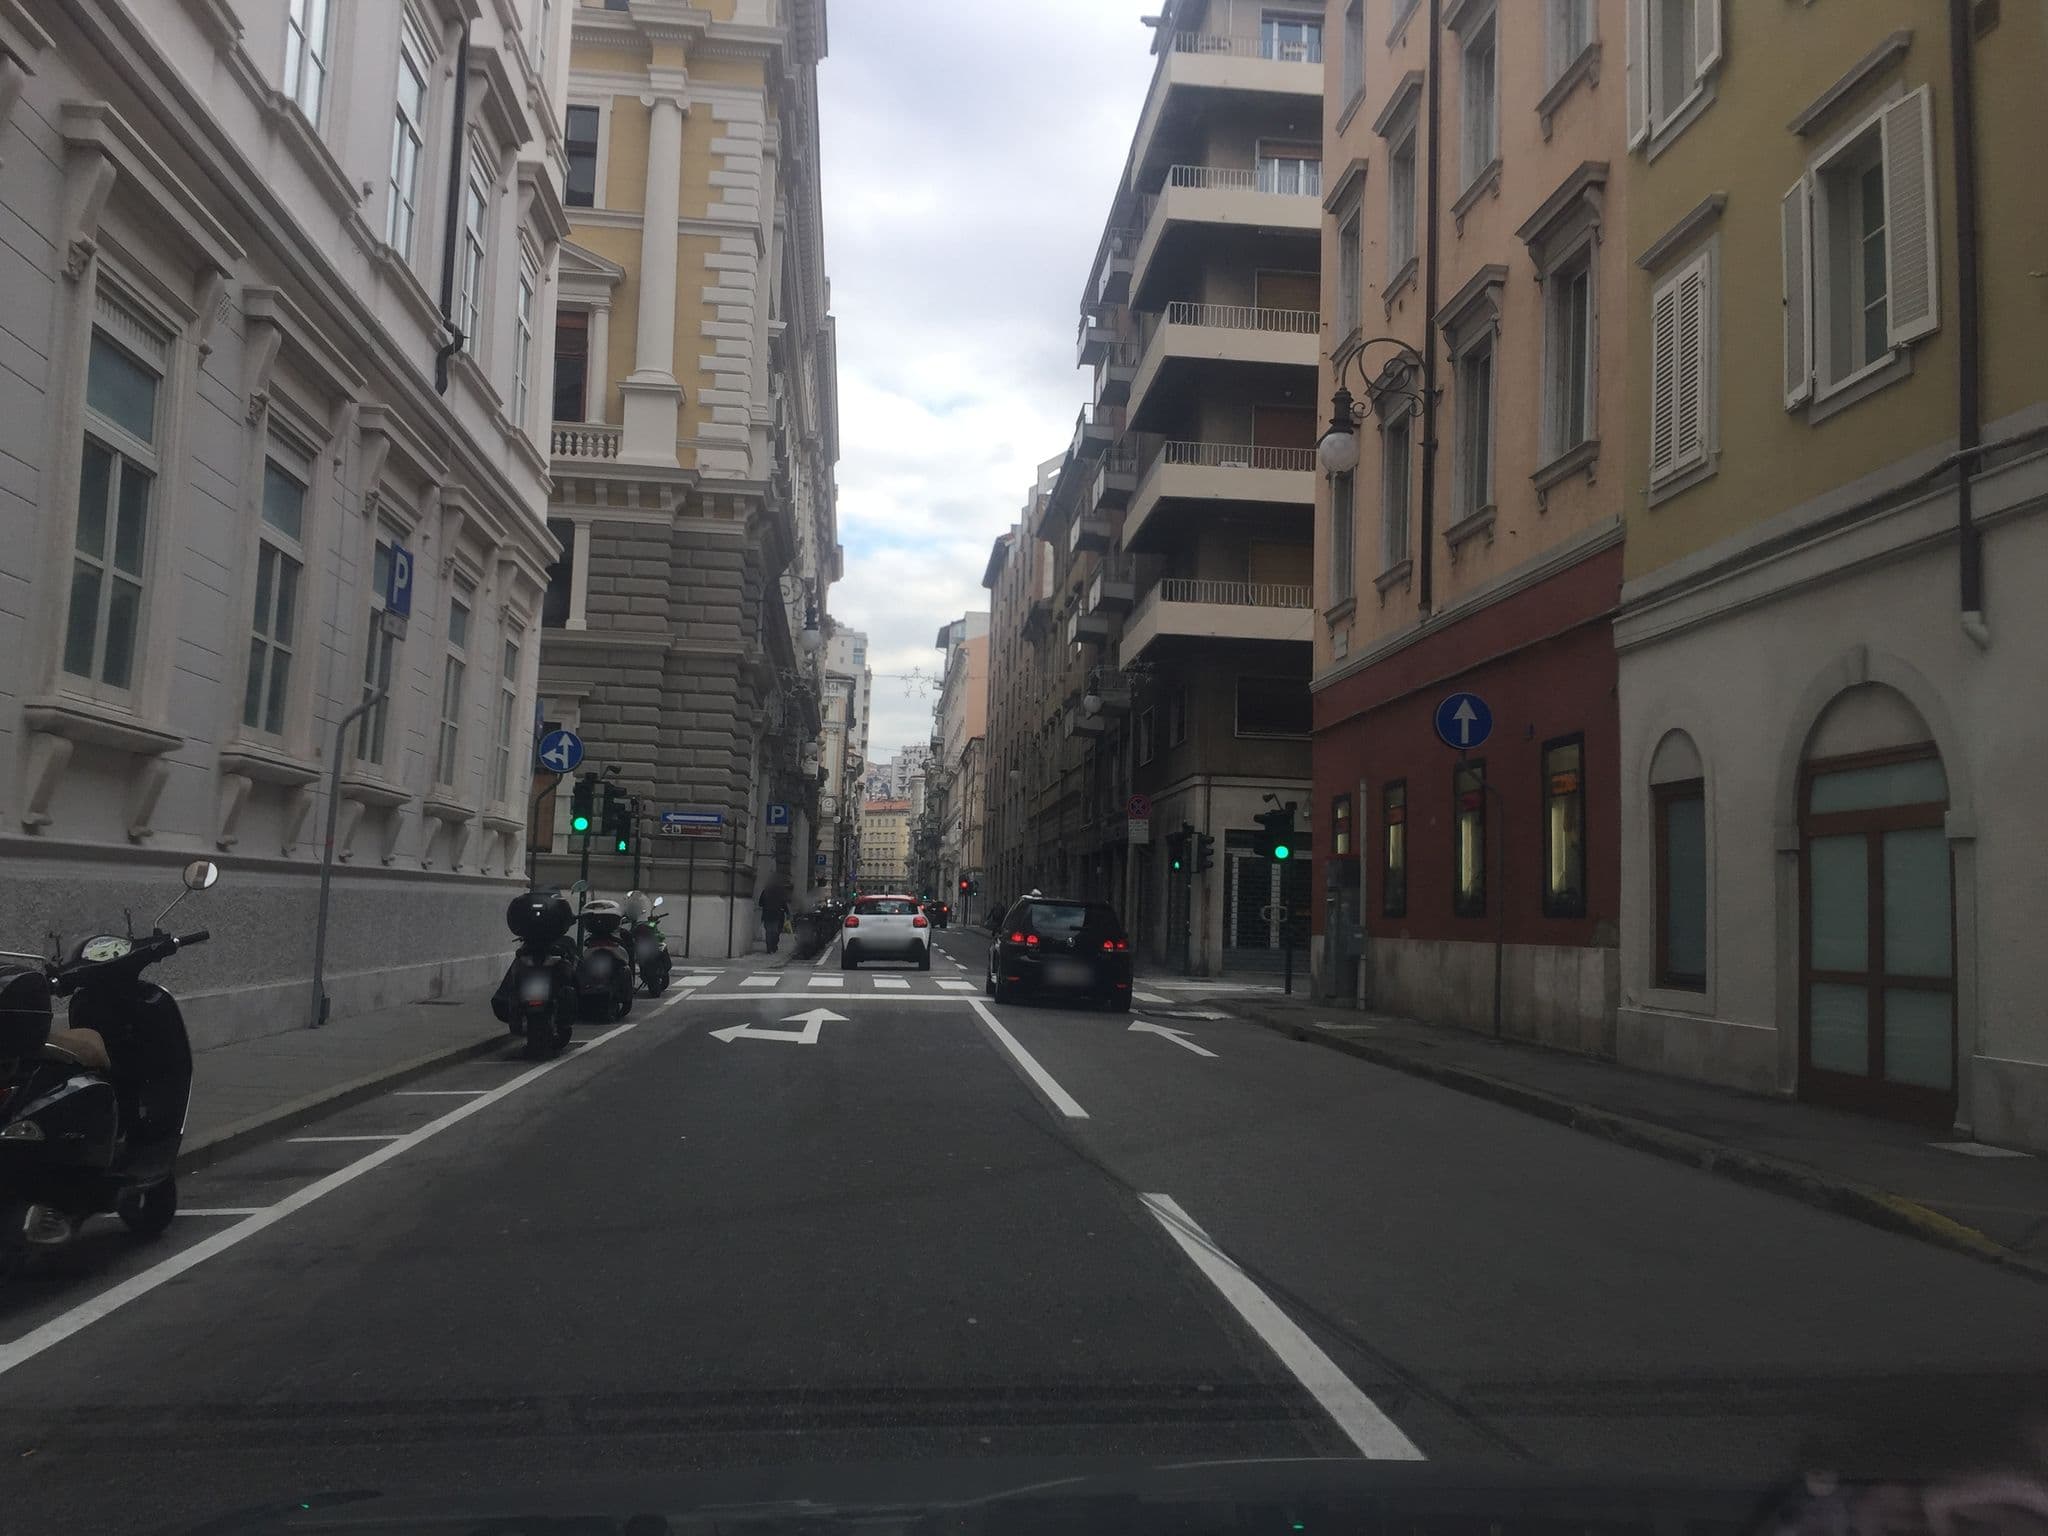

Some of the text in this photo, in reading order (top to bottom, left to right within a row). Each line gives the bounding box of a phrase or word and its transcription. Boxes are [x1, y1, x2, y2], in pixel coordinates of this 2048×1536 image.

[393, 552, 409, 604] P
[771, 806, 785, 823] P
[817, 855, 825, 864] P
